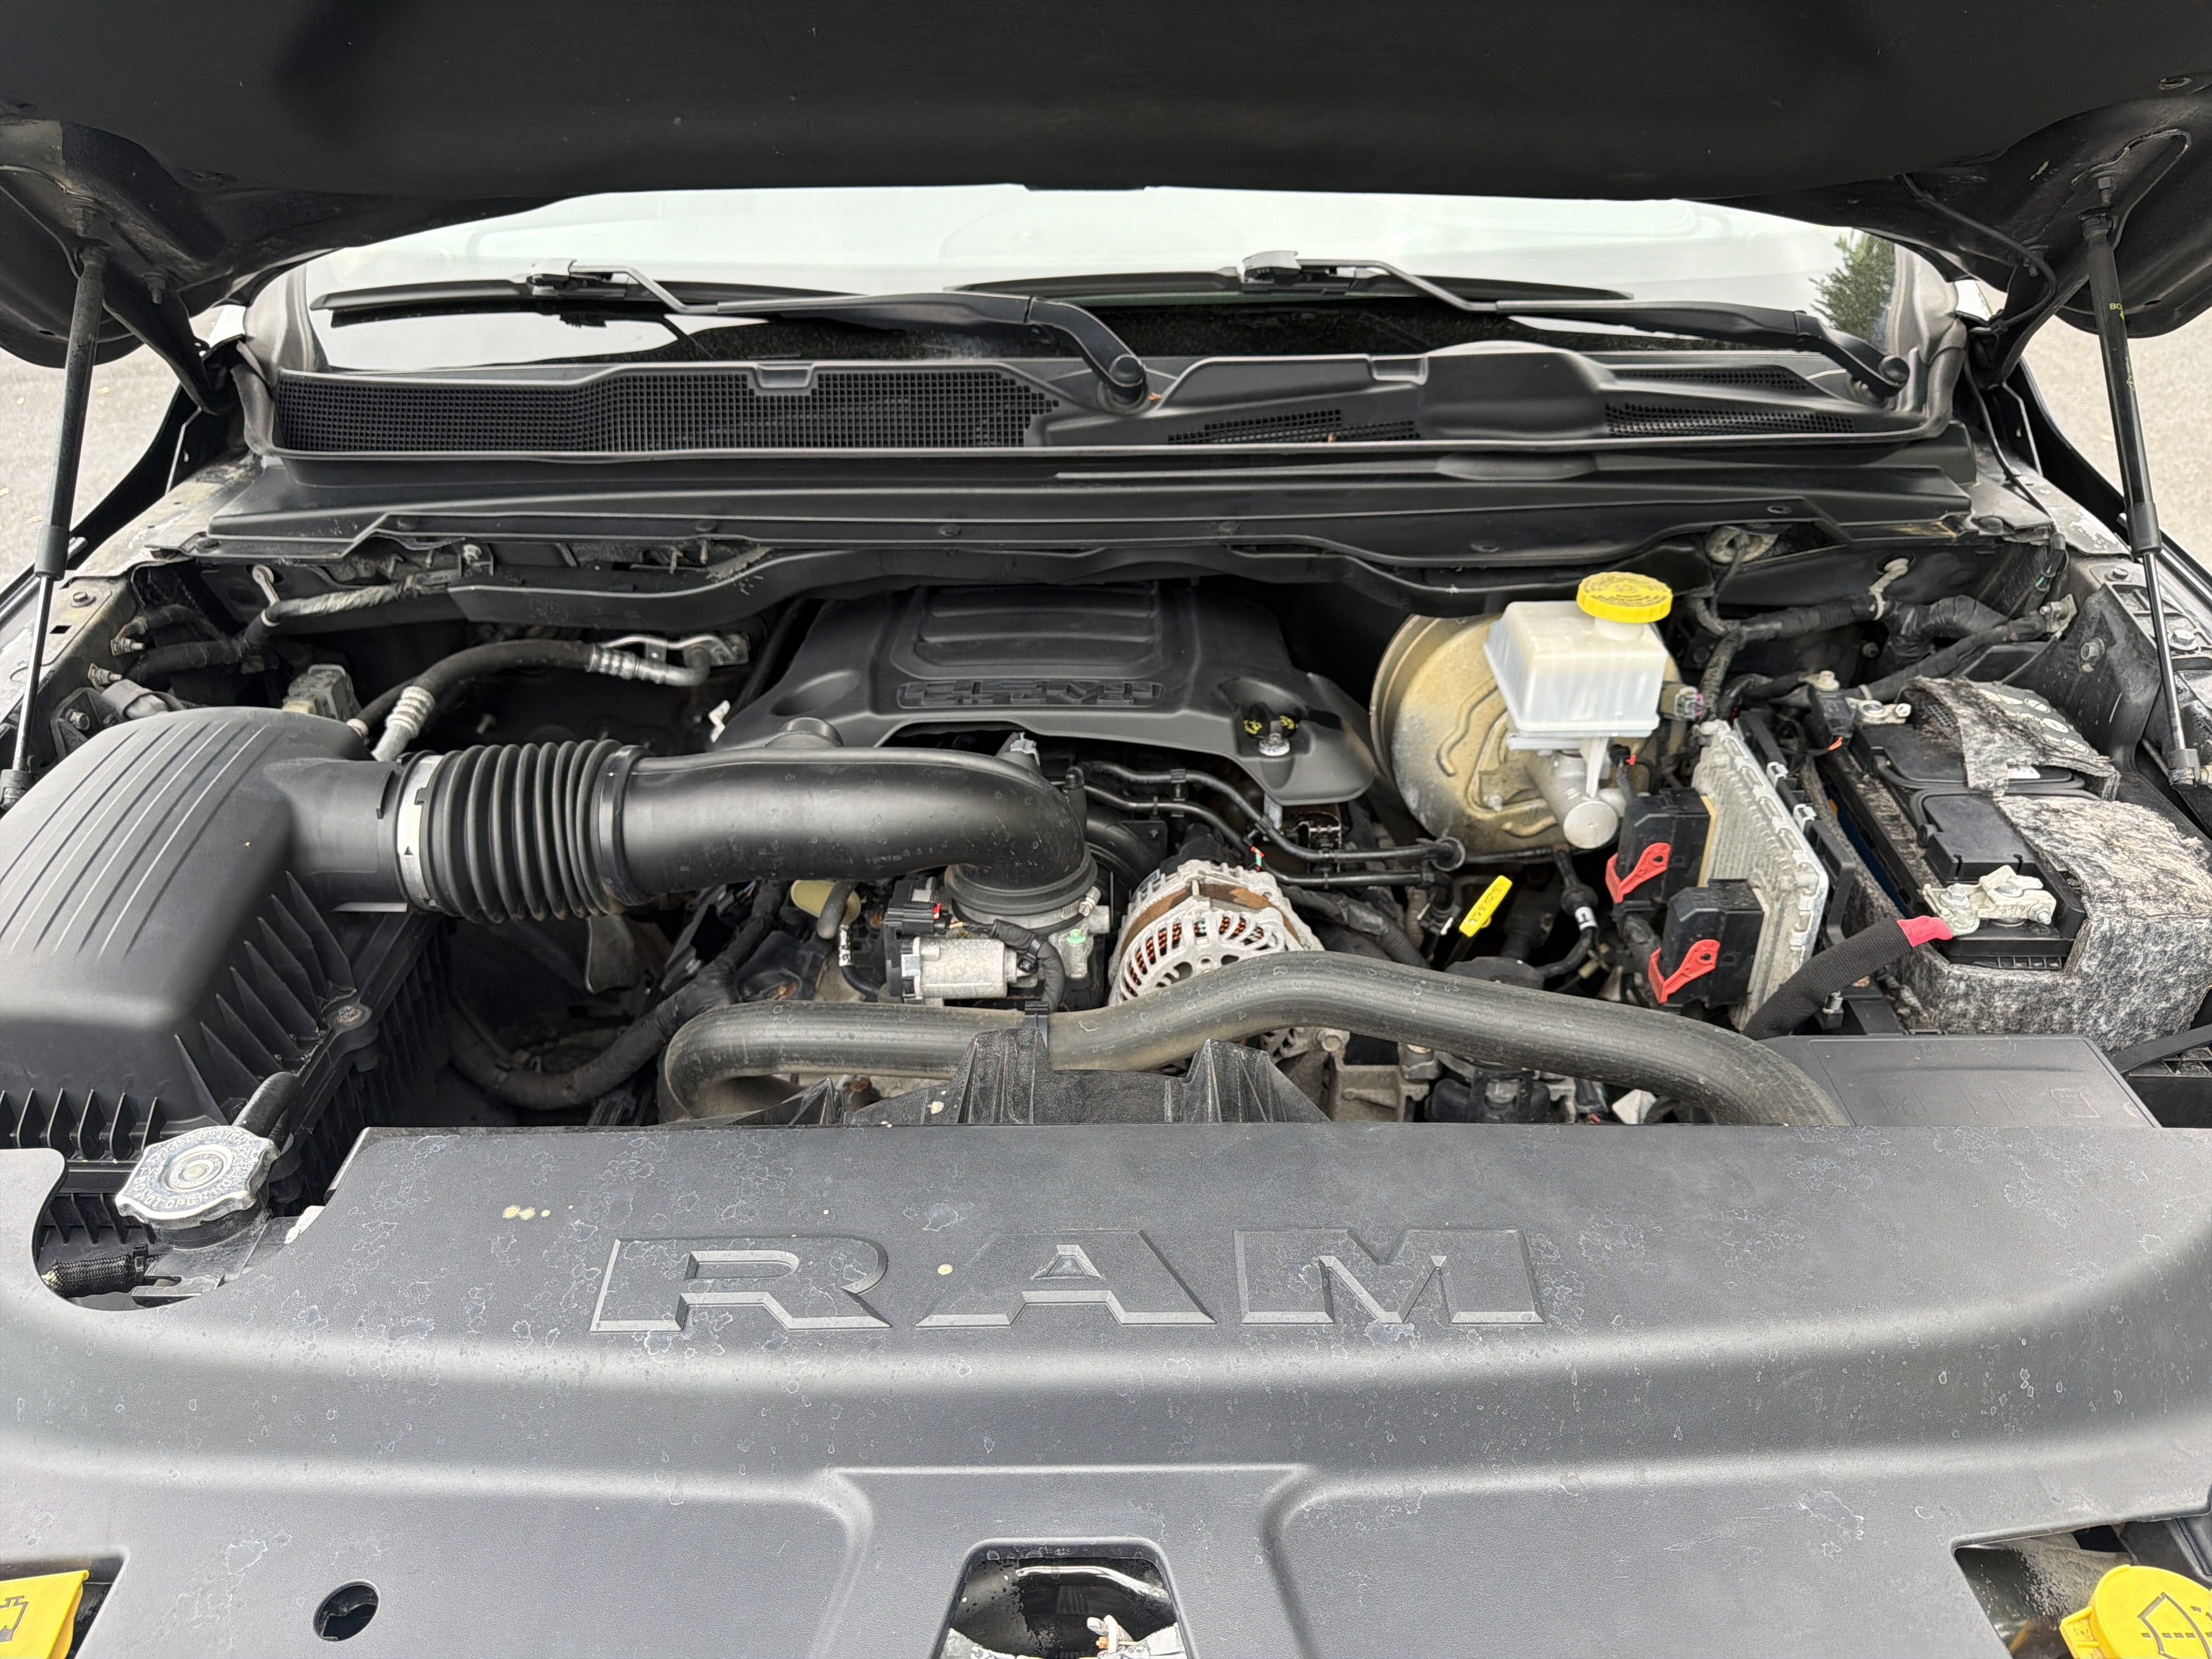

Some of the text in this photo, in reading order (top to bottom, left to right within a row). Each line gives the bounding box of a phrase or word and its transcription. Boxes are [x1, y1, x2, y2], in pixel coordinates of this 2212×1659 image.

[135, 1189, 165, 1209] NOT
[165, 1191, 209, 1209] OPEN
[590, 1228, 1545, 1332] RAM
